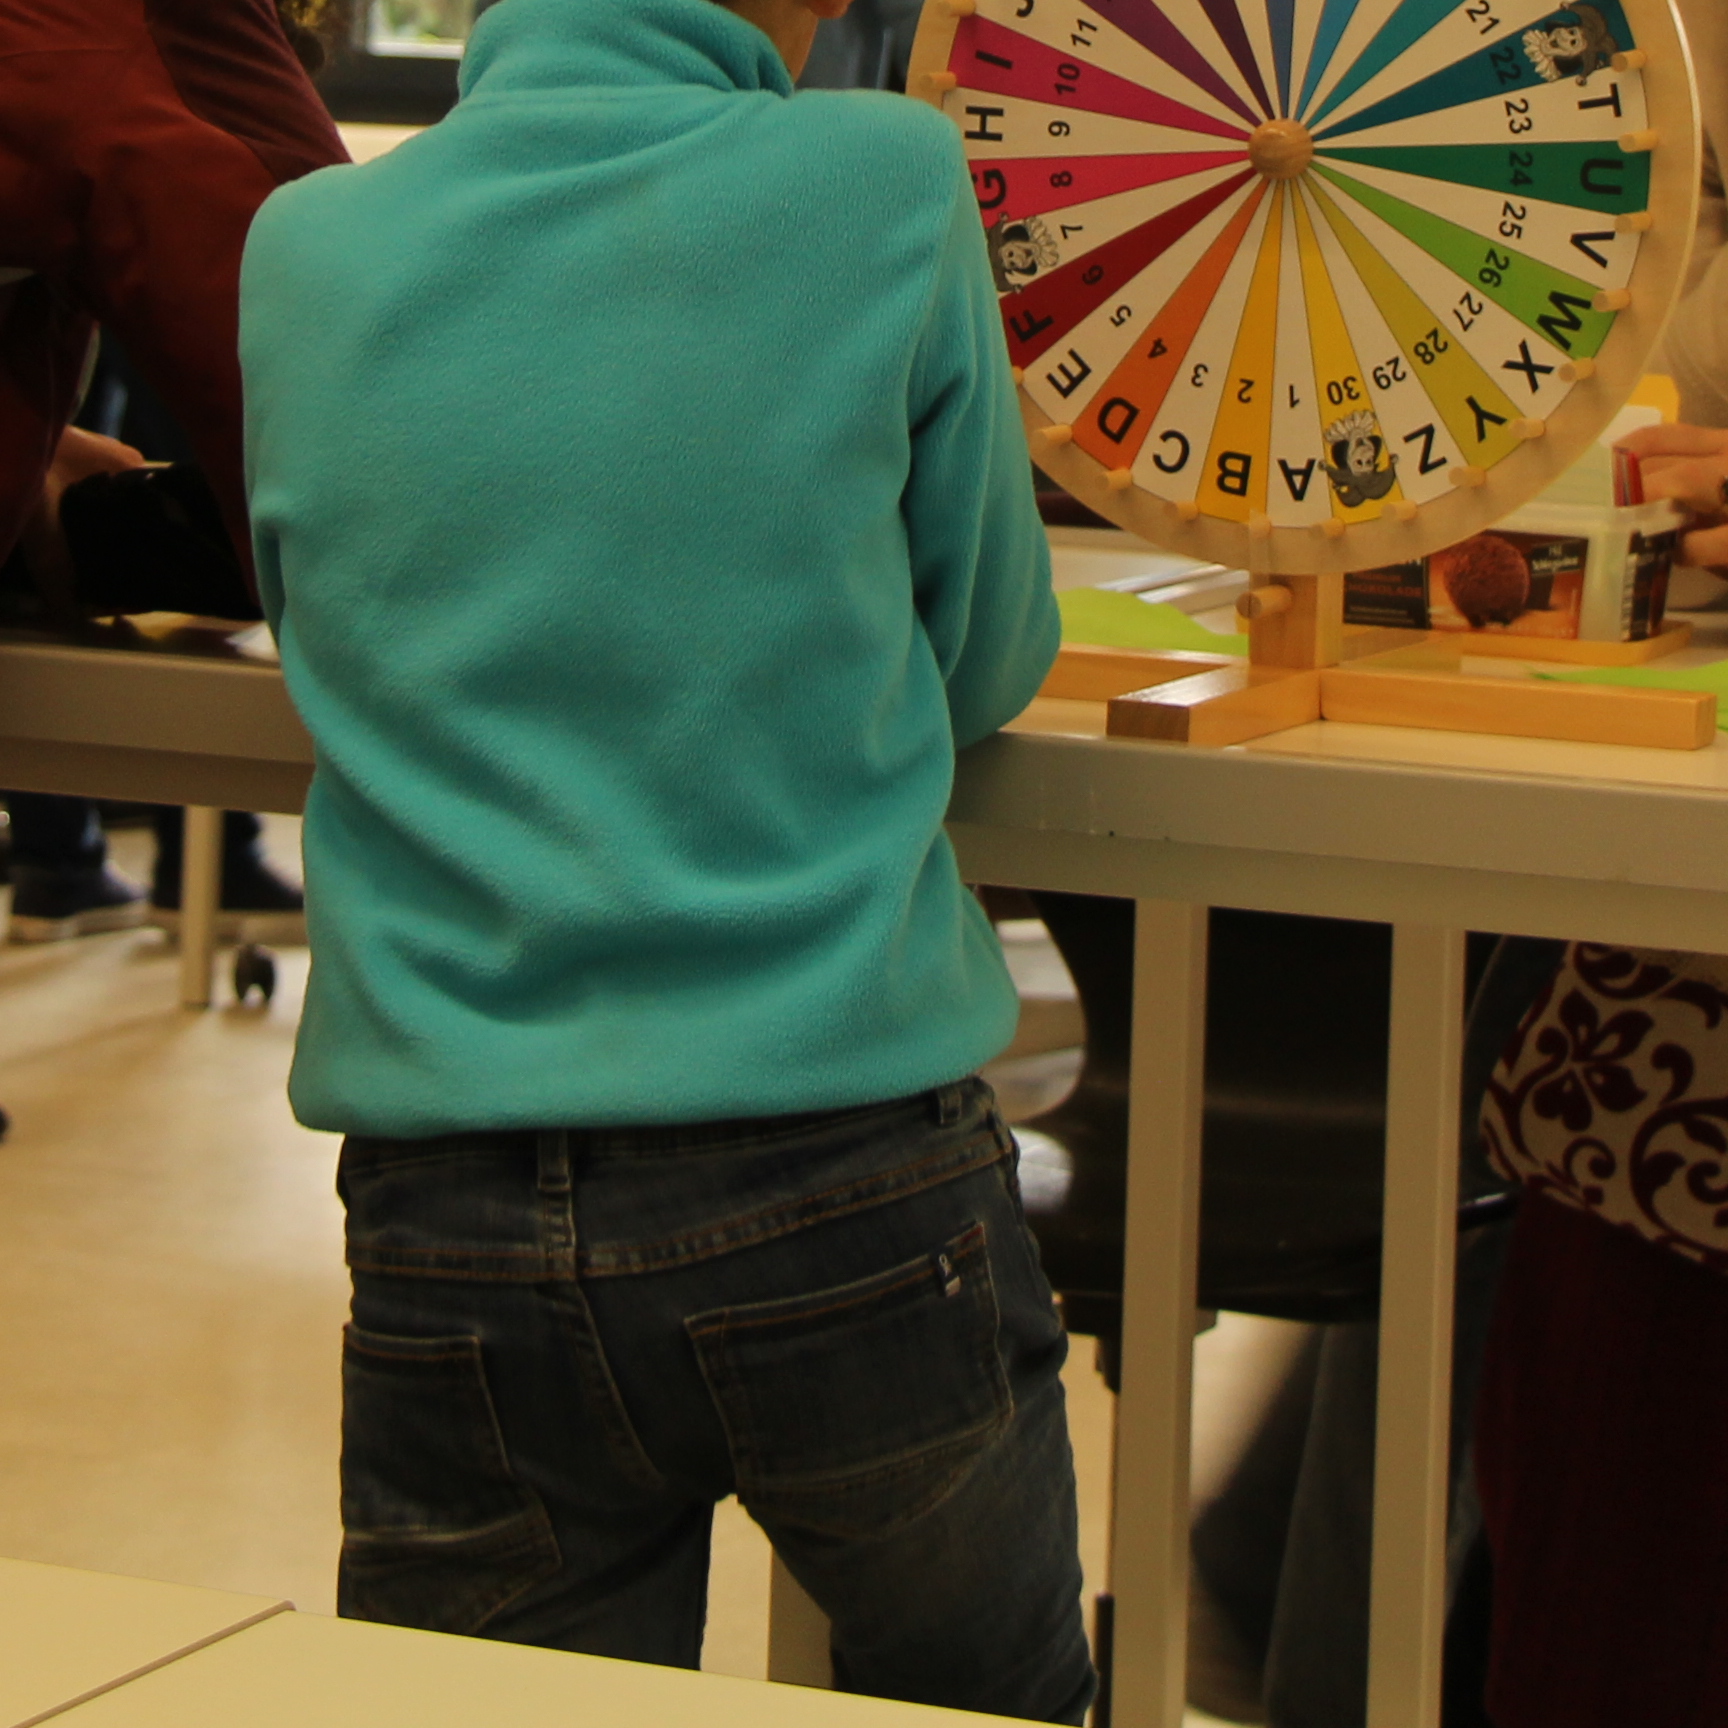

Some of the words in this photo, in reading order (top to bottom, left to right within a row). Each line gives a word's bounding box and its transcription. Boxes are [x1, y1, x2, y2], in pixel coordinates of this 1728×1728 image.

[1071, 16, 1098, 51] 11
[1468, 0, 1500, 34] 21
[975, 49, 1013, 70] I
[1489, 46, 1520, 84] 22
[1054, 63, 1082, 96] 10
[1505, 101, 1533, 134] 23
[1577, 84, 1622, 119] T
[965, 106, 1004, 141] H
[1048, 120, 1070, 137] 9
[1050, 170, 1072, 187] 8
[1508, 151, 1534, 186] 24
[1579, 157, 1624, 195] U
[974, 167, 1006, 210] G
[1062, 219, 1083, 240] 7
[1499, 204, 1527, 240] 25
[1570, 228, 1616, 268] V
[1083, 263, 1104, 286] 6
[1478, 249, 1511, 288] 26
[1011, 308, 1053, 343] F
[1109, 304, 1133, 328] 5
[1452, 291, 1484, 331] 27
[1536, 290, 1592, 350] W
[1146, 337, 1169, 361] 4
[1413, 328, 1449, 365] 28
[1045, 349, 1093, 399] E
[1191, 363, 1209, 388] 3
[1371, 356, 1406, 392] 29
[1503, 340, 1555, 394] X
[1236, 378, 1255, 404] 2
[1288, 385, 1300, 408] 1
[1326, 375, 1360, 404] 30
[1096, 395, 1141, 444] D
[1467, 397, 1508, 444] Y
[1152, 429, 1191, 473] C
[1404, 423, 1449, 475] Z
[1217, 451, 1253, 496] B
[1278, 458, 1316, 501] A
